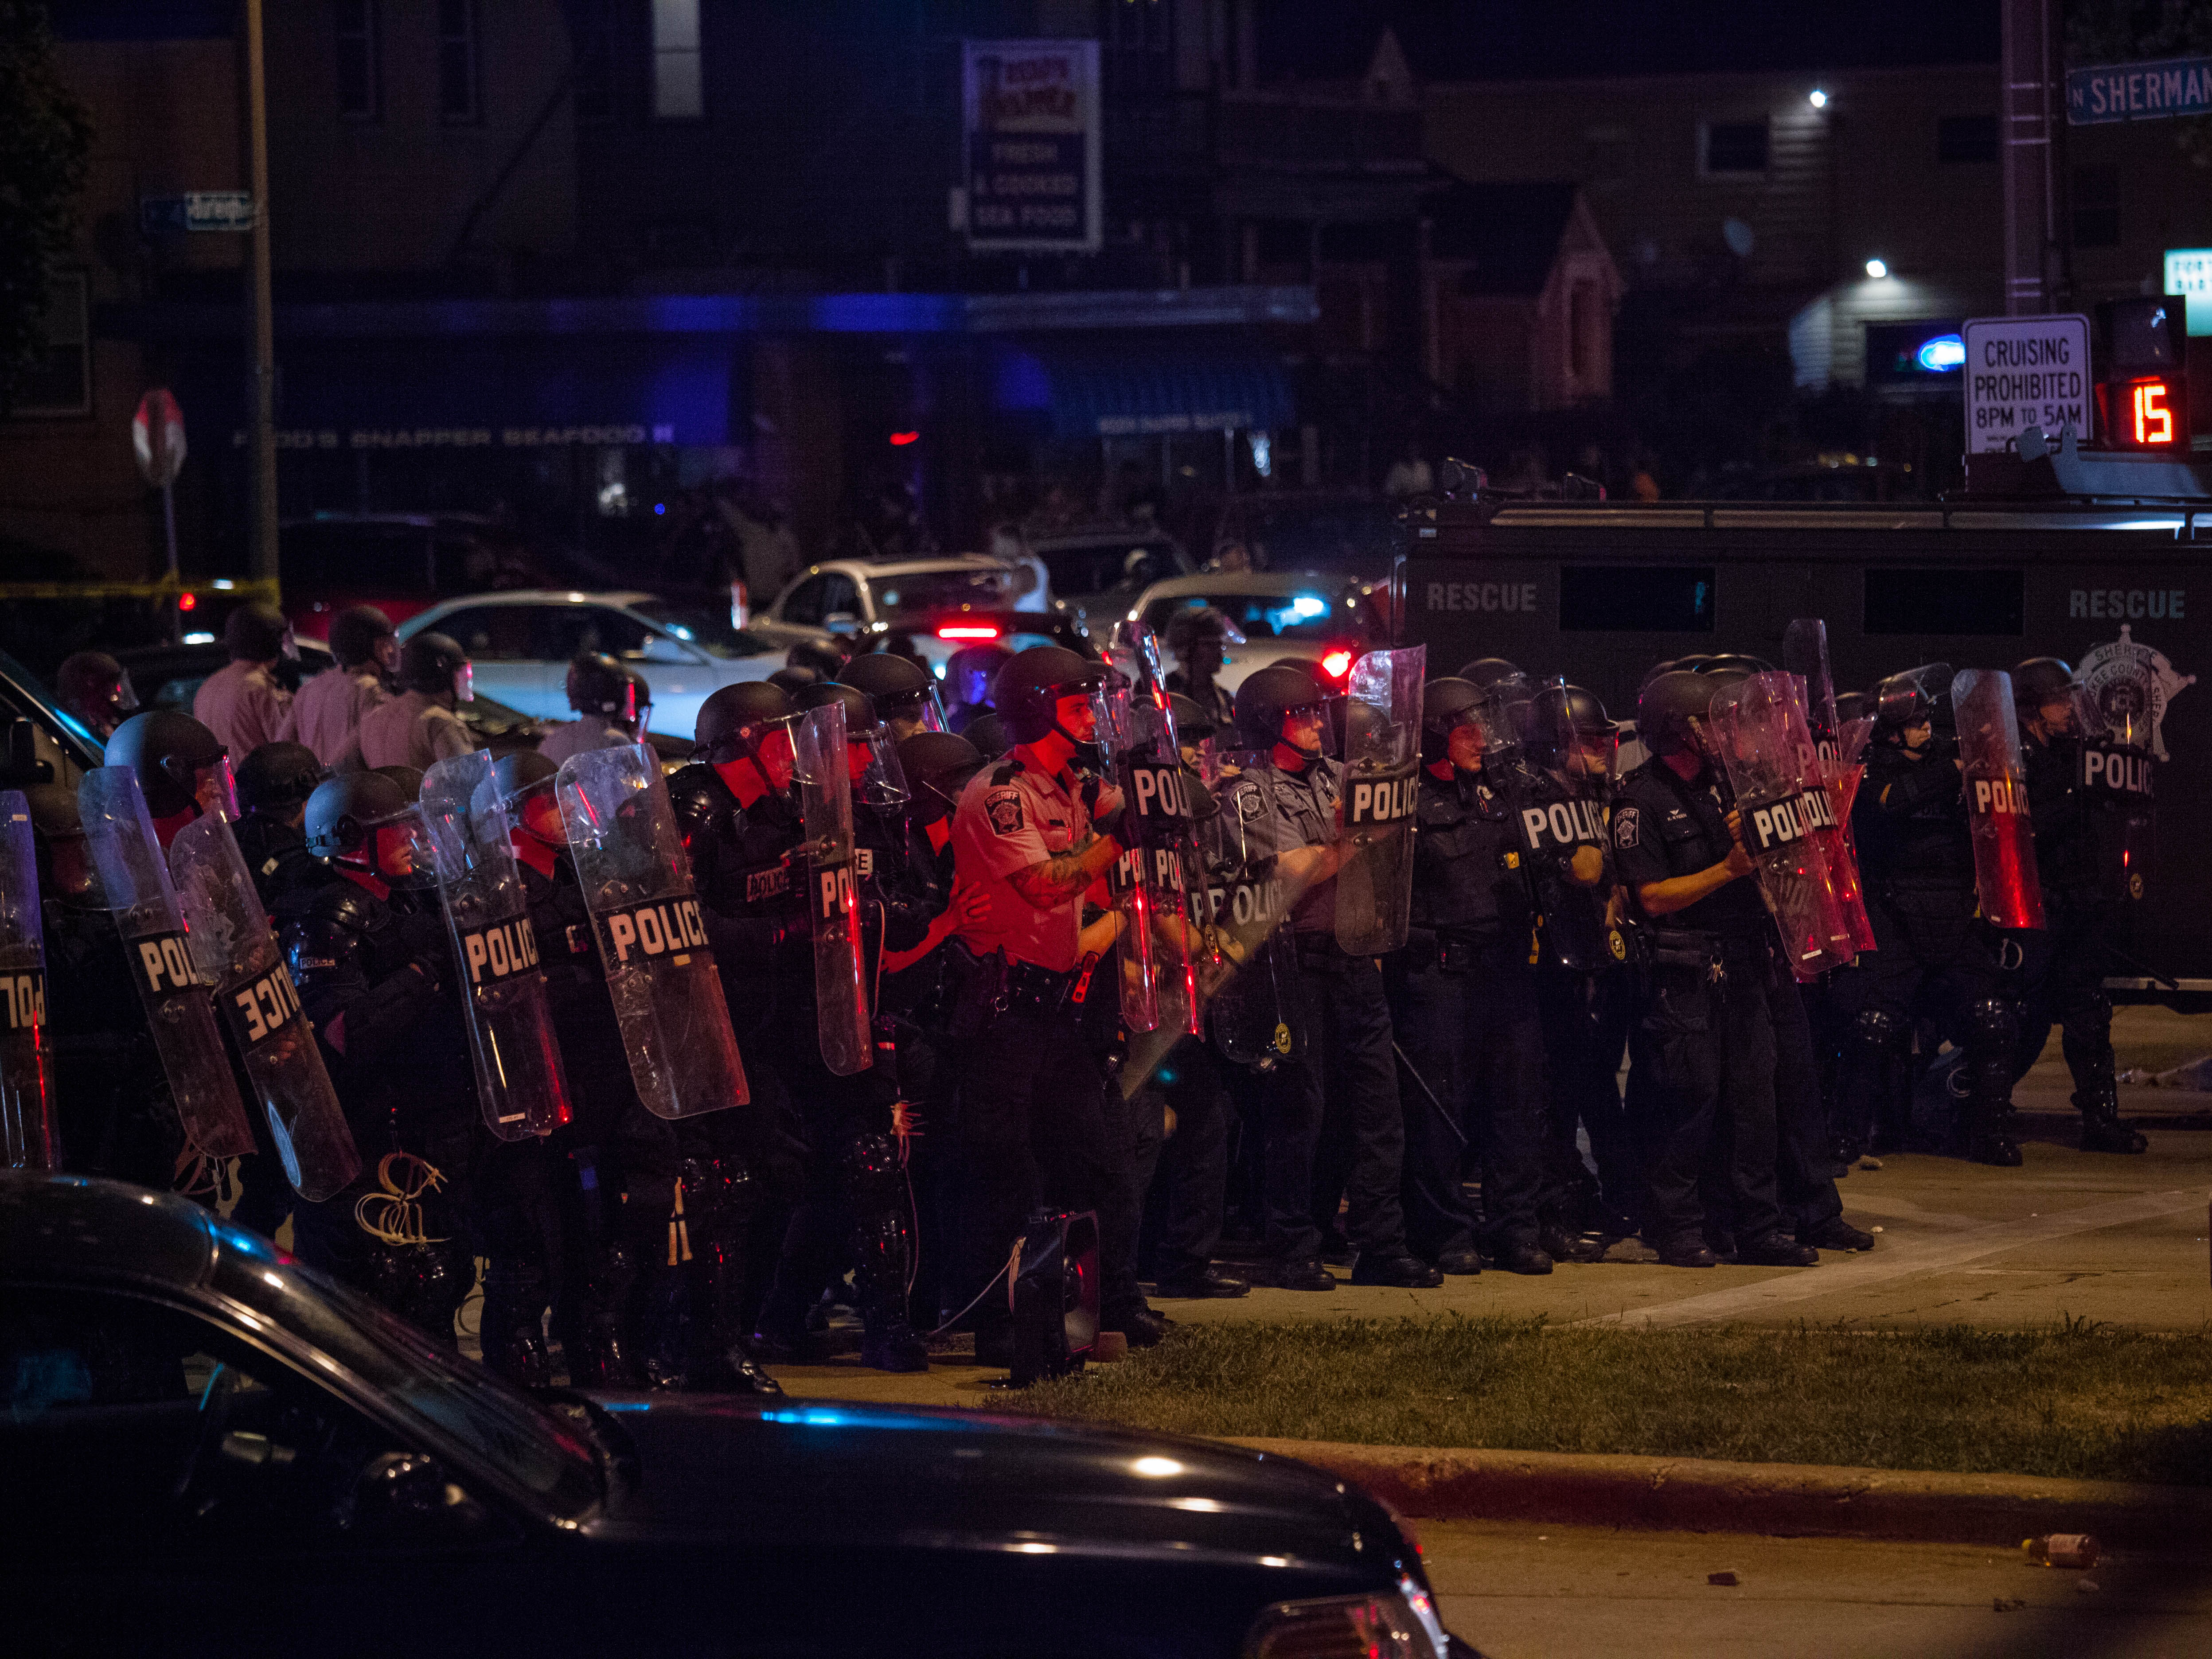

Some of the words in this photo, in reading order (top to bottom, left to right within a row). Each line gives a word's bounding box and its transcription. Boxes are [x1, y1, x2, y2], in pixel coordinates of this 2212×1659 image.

[2072, 88, 2083, 108] N
[2091, 67, 2212, 114] SHERMAN
[1985, 338, 2069, 367] CRUISING
[1975, 371, 2081, 401] PROHIBITED
[1977, 407, 2013, 428] 8PM
[2021, 408, 2036, 424] TO
[2044, 404, 2081, 426] 5AM
[2134, 384, 2173, 443] 15
[1427, 582, 1537, 612] RESCUE
[2069, 589, 2186, 619] RESCUE
[986, 791, 1018, 807] SHERIFF
